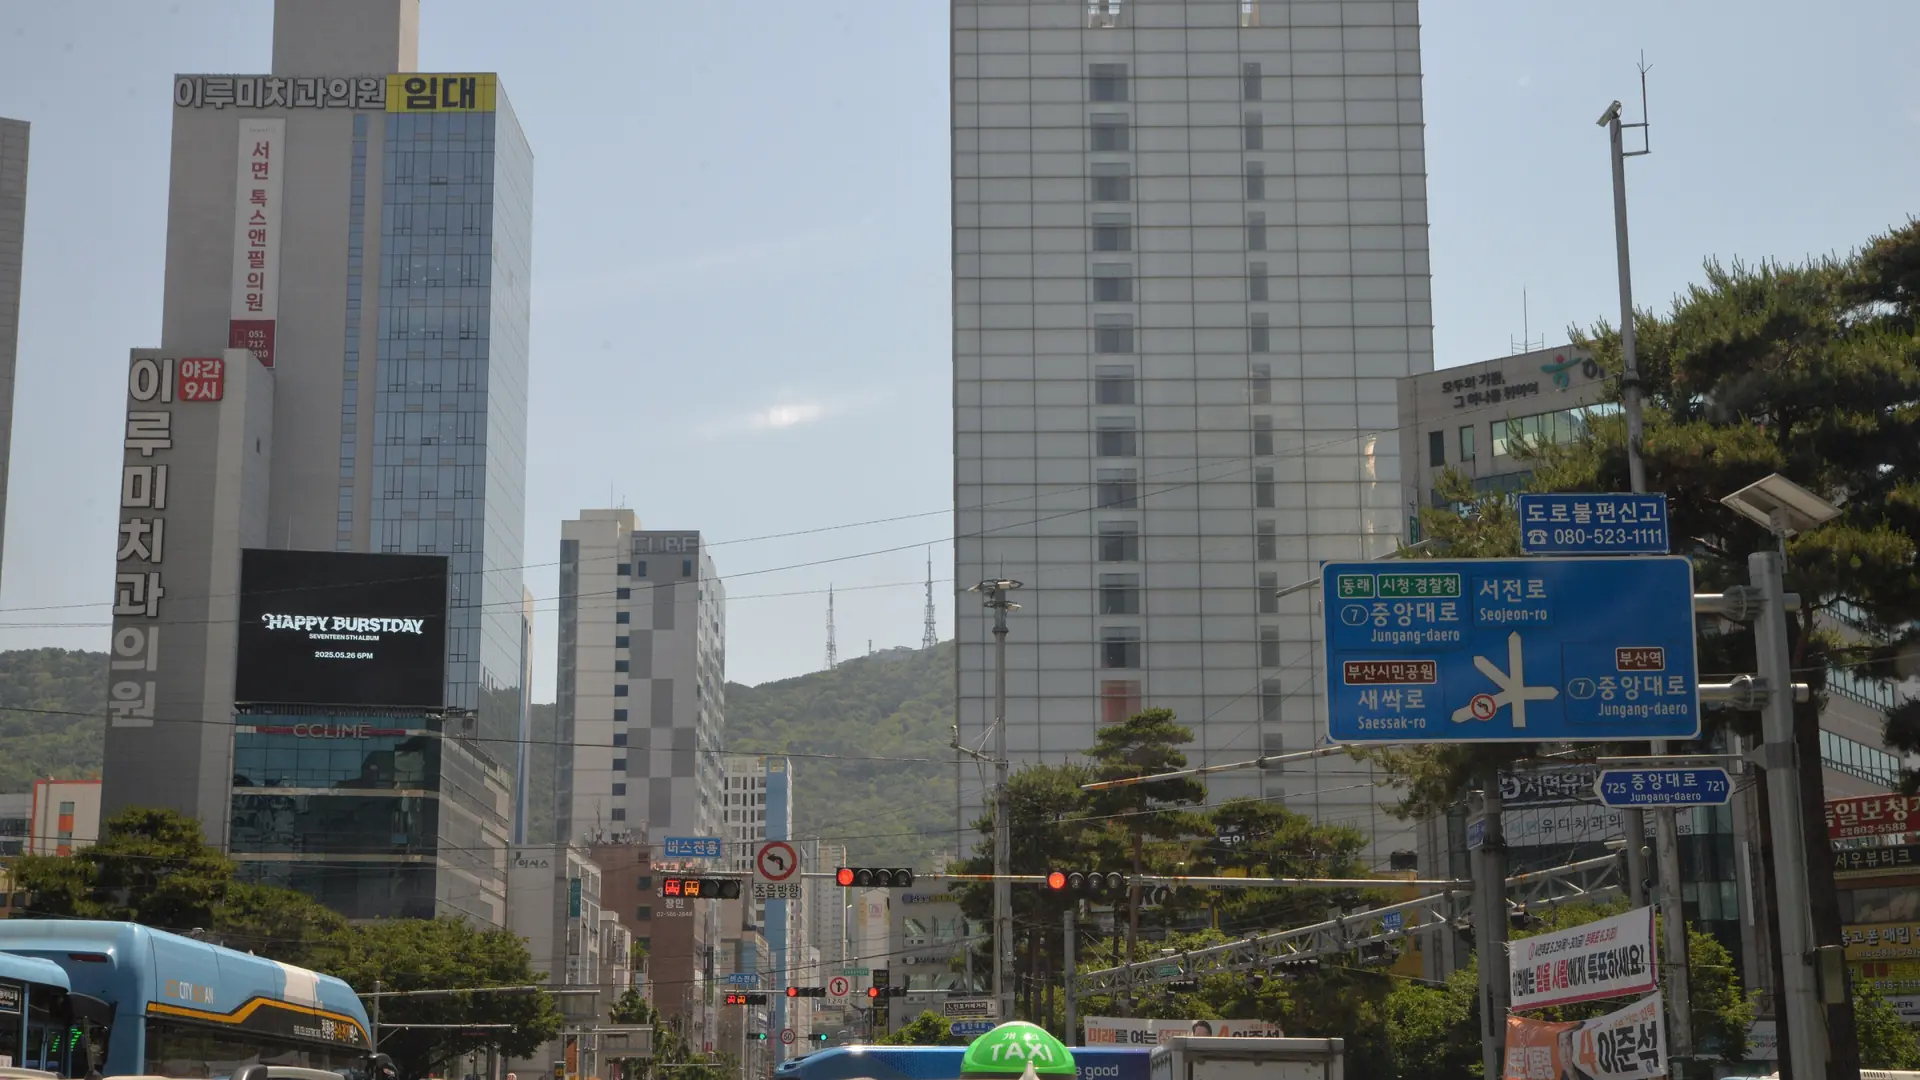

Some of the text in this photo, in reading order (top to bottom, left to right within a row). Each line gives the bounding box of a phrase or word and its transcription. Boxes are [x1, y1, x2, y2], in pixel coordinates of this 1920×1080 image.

[174, 77, 386, 109] 이루미치과의원
[404, 76, 476, 109] 임대
[245, 141, 270, 312] 서면 톡스앤필의원
[182, 360, 222, 379] 야간
[184, 381, 218, 400] 9시
[1526, 502, 1661, 524] 도로불편신고
[109, 358, 174, 728] 이루미치과의원
[1554, 528, 1663, 545] 080-523-1111
[1341, 577, 1371, 595] 동래
[1479, 579, 1547, 602] 서전로
[1350, 602, 1459, 626] 7 중앙대로
[1480, 607, 1547, 624] Seojeon-ro
[261, 613, 425, 634] HAPPY BURSTDAY
[309, 633, 345, 641] SEVENTEEN
[1371, 628, 1460, 644] Jungang-daero
[315, 651, 374, 660] 2025.05.26 6PM
[1619, 650, 1662, 667] 부산역
[1347, 663, 1434, 681] 부산시민공원
[1577, 676, 1687, 700] 7 중앙대로
[1358, 689, 1426, 710] 새싹로
[1598, 701, 1688, 717] Jungang-daero
[1358, 716, 1426, 730] Saessak-ro
[1606, 771, 1726, 795] 725 중앙대로 721
[1629, 791, 1701, 803] Jungang-daero
[667, 839, 718, 856] 버스전용
[755, 883, 799, 899] 초읍방향
[1882, 926, 1911, 944] 매입
[1535, 961, 1552, 992] 믿을
[1552, 955, 1587, 991] 사람에게
[1587, 944, 1646, 984] 투표하세요!
[179, 980, 193, 1000] CITY
[783, 1032, 793, 1041] 50
[1087, 1027, 1128, 1044] 미래를
[1130, 1029, 1158, 1045] 여는
[991, 1042, 1054, 1062] TAXI
[1578, 1030, 1598, 1074] 4
[1598, 1020, 1660, 1074] 이준석
[1085, 1063, 1119, 1080] good
